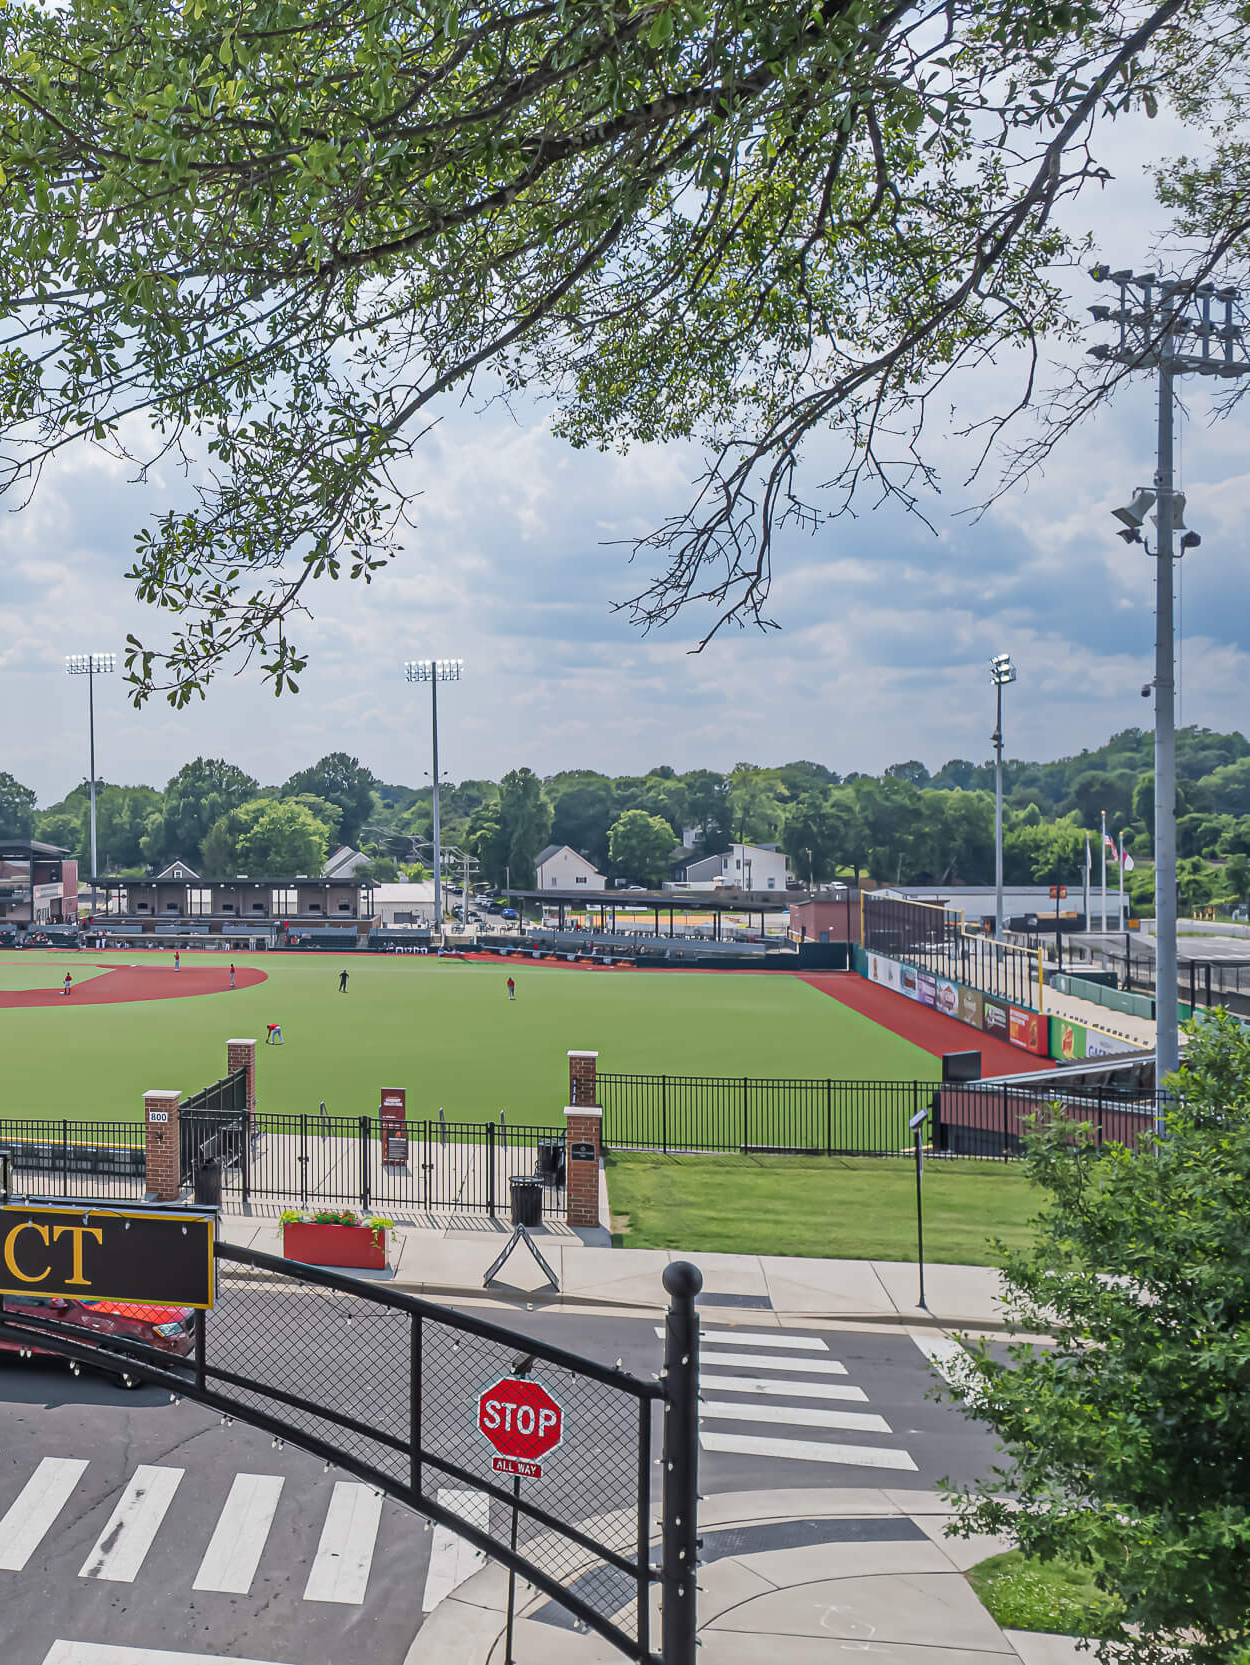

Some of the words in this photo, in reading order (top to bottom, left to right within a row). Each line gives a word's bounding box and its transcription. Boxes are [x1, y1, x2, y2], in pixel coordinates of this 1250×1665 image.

[151, 1113, 166, 1121] 800
[484, 1400, 557, 1437] STOP
[496, 1460, 515, 1472] ALL
[518, 1463, 537, 1475] WAY
